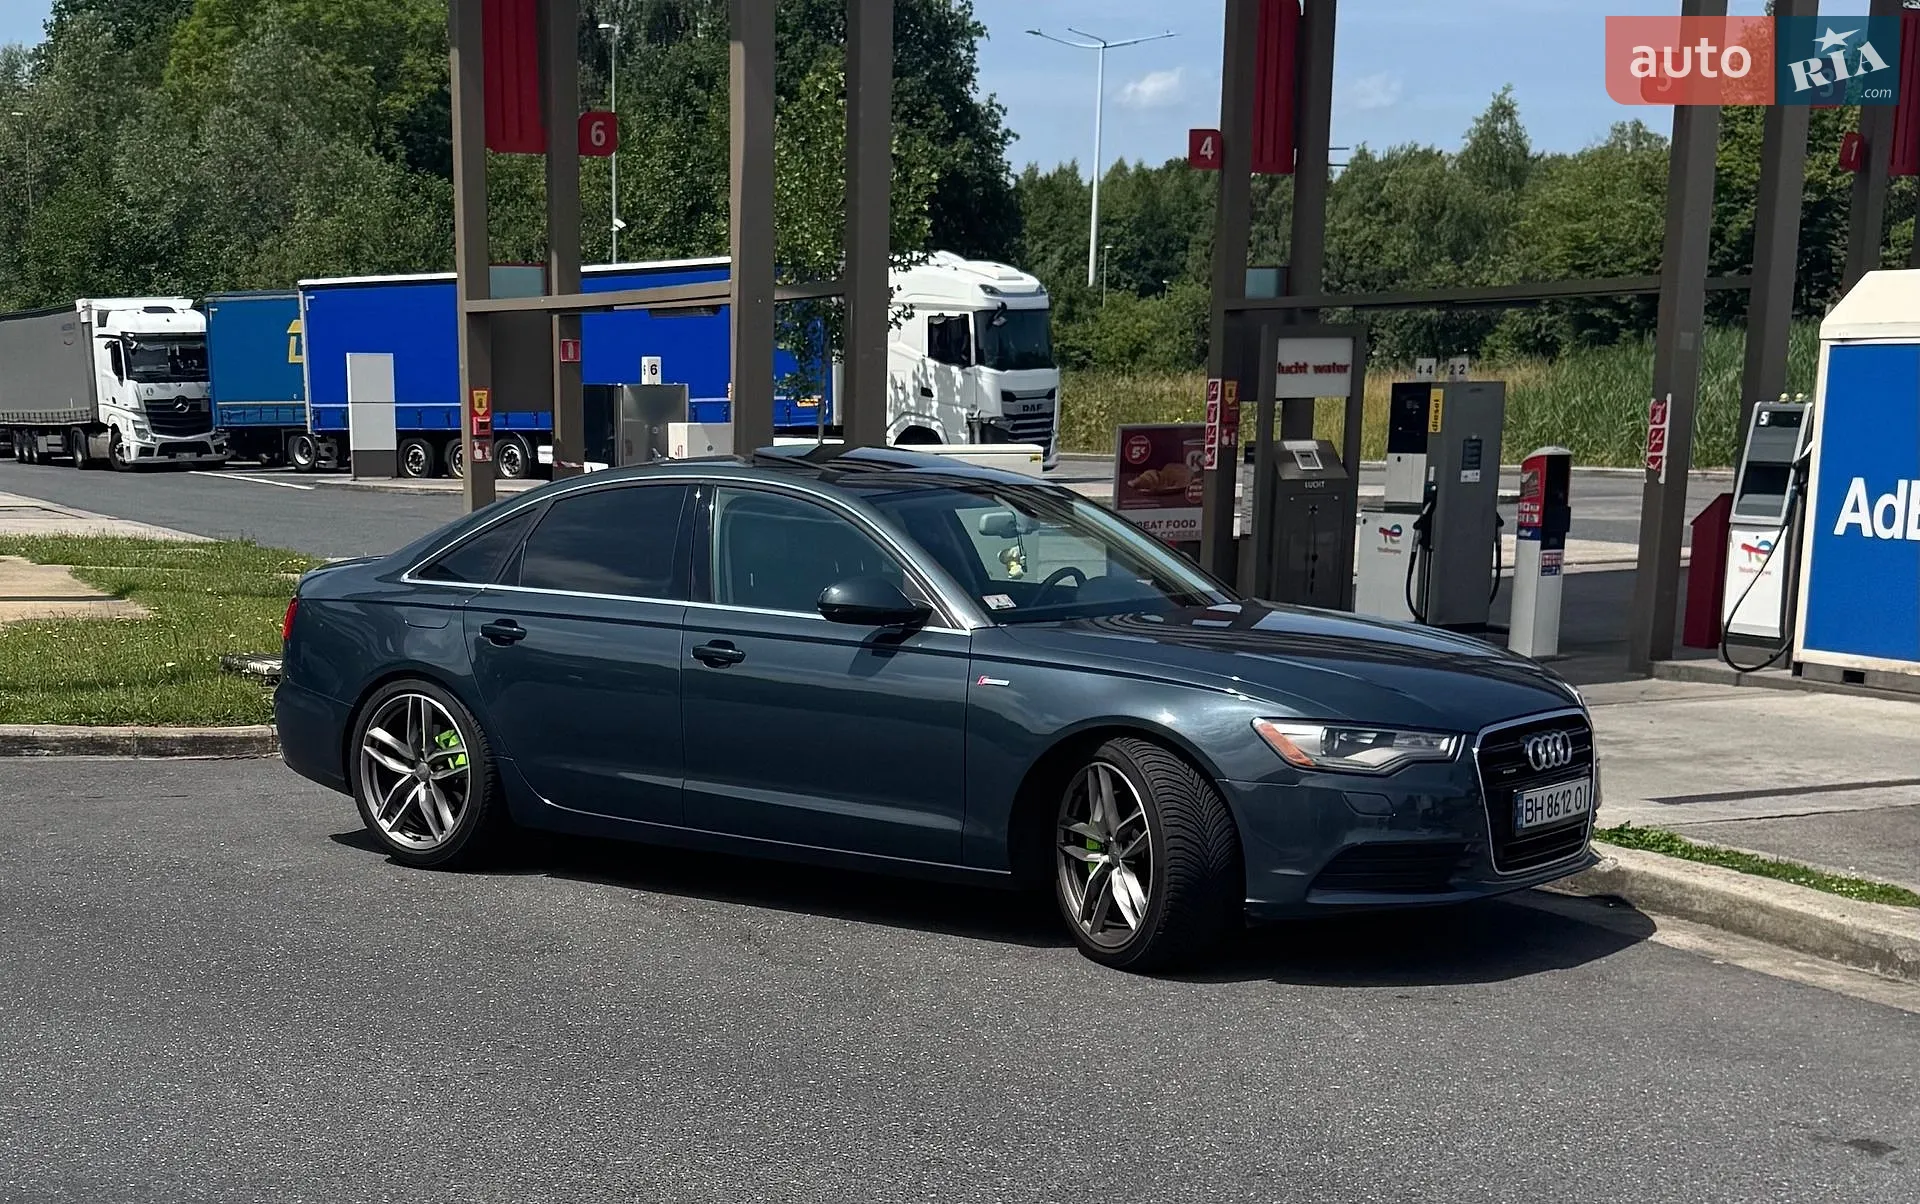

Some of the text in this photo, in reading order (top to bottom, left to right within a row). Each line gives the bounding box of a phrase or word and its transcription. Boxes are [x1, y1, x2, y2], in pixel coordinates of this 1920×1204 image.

[591, 121, 606, 147] 6
[1200, 136, 1214, 161] 4
[1851, 140, 1858, 162] 1
[650, 364, 658, 376] 6
[1313, 362, 1350, 374] water
[1459, 364, 1466, 376] 2
[1022, 404, 1043, 413] DAF
[1431, 399, 1441, 432] diesel
[1759, 411, 1770, 426] 5
[1166, 519, 1197, 529] FOOD
[1525, 785, 1587, 824] BH 8612 OI
